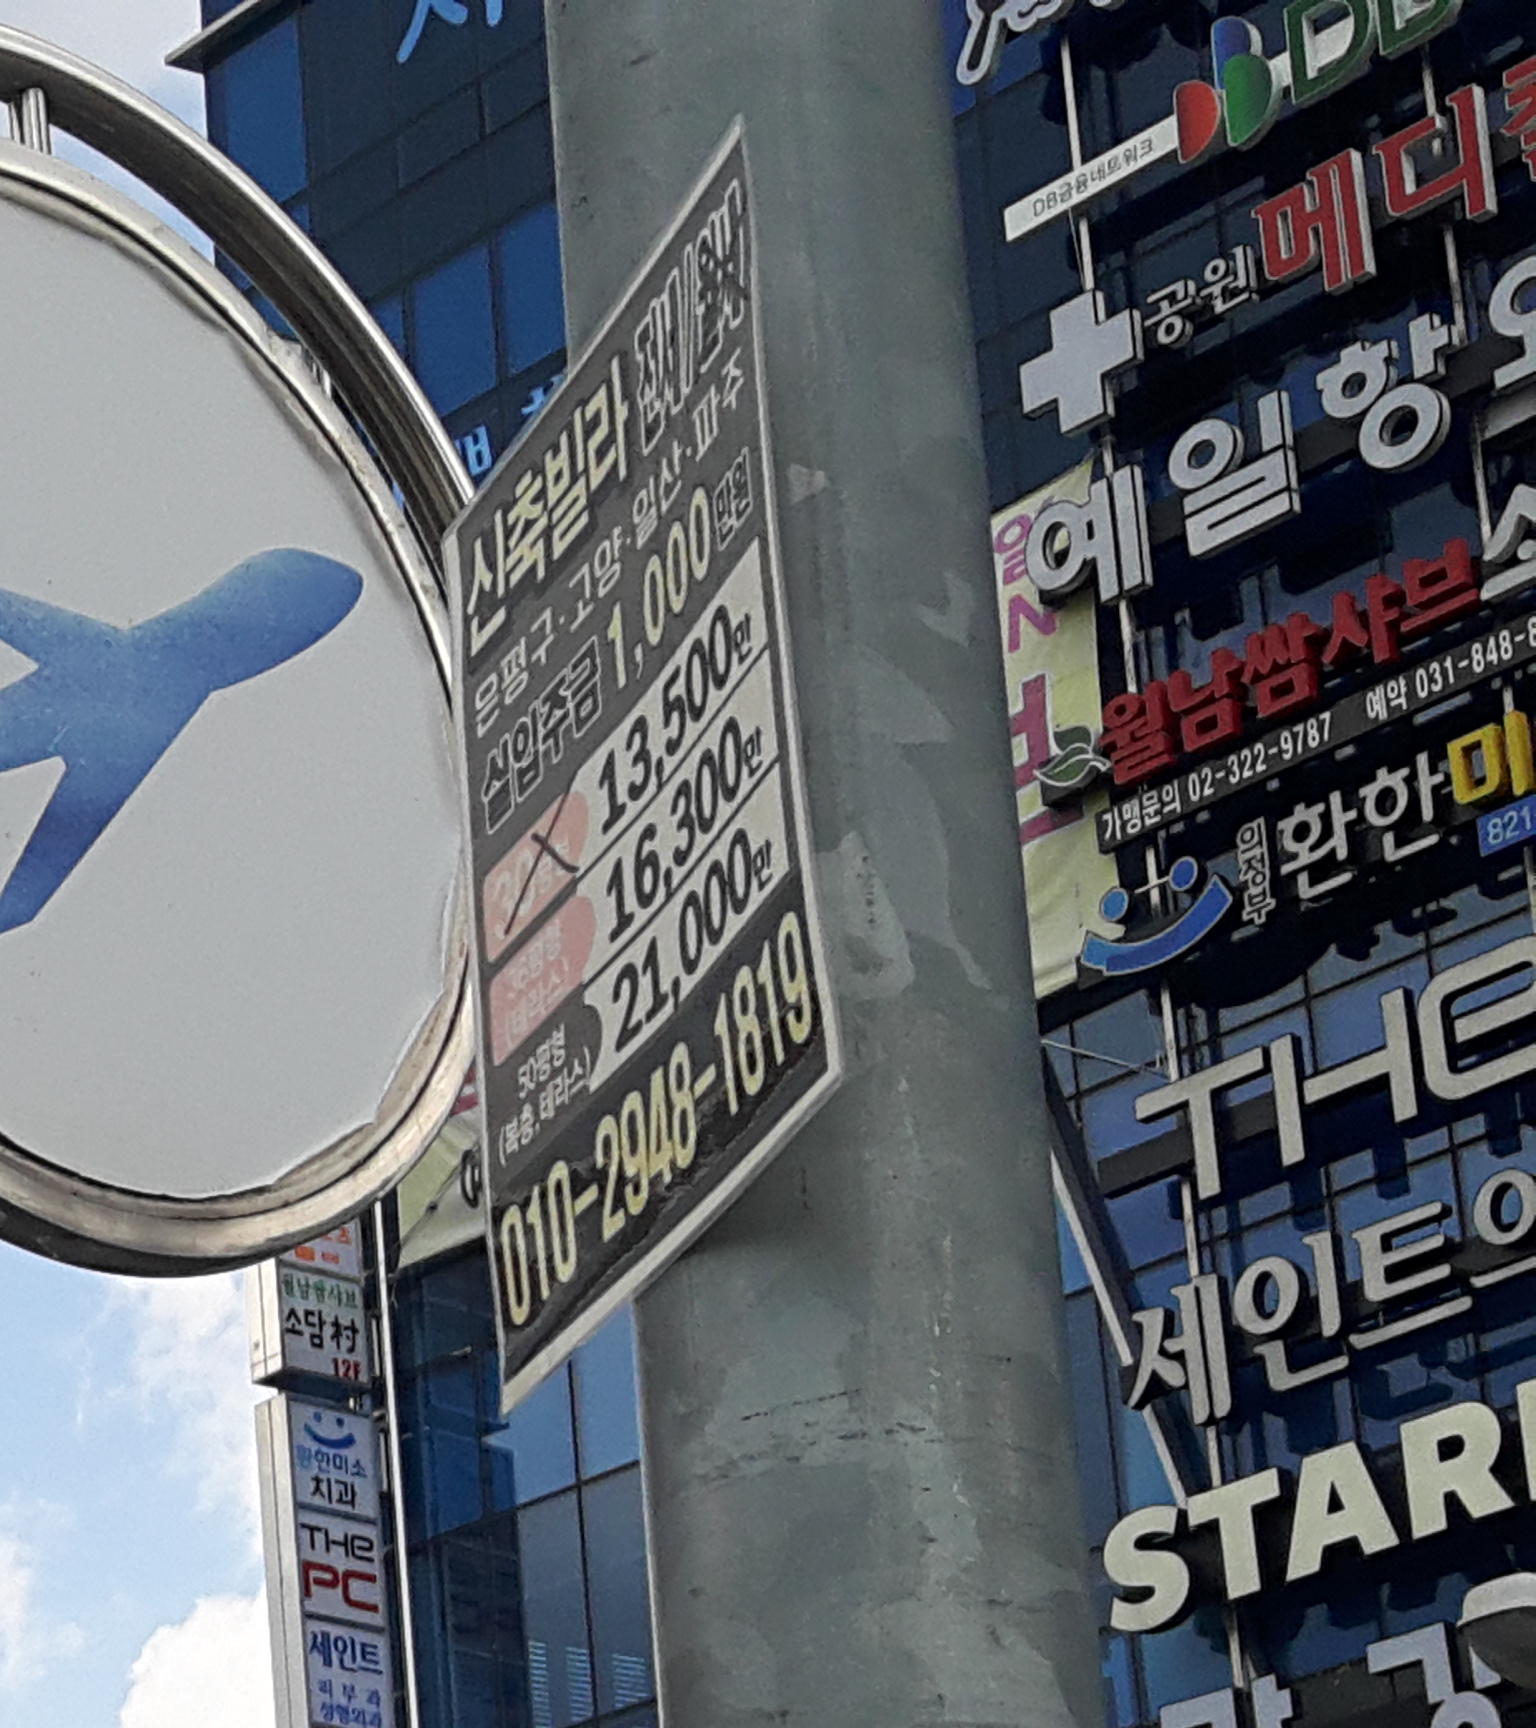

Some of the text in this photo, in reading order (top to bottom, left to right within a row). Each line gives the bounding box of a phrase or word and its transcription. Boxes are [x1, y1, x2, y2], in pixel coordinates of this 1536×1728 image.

[1145, 246, 1260, 346] 공원
[467, 353, 628, 656] 신축빌라
[481, 634, 602, 835] 실입주금
[1098, 536, 1482, 786] 월남쌈샤브
[1186, 711, 1333, 803] 02-322-9787
[1365, 675, 1409, 722] 예약
[499, 911, 814, 1328] 010-2948-1819
[332, 1357, 361, 1383] 12F
[310, 1474, 359, 1511] 치과
[1102, 1377, 1536, 1633] STAR
[302, 1559, 380, 1615] PC
